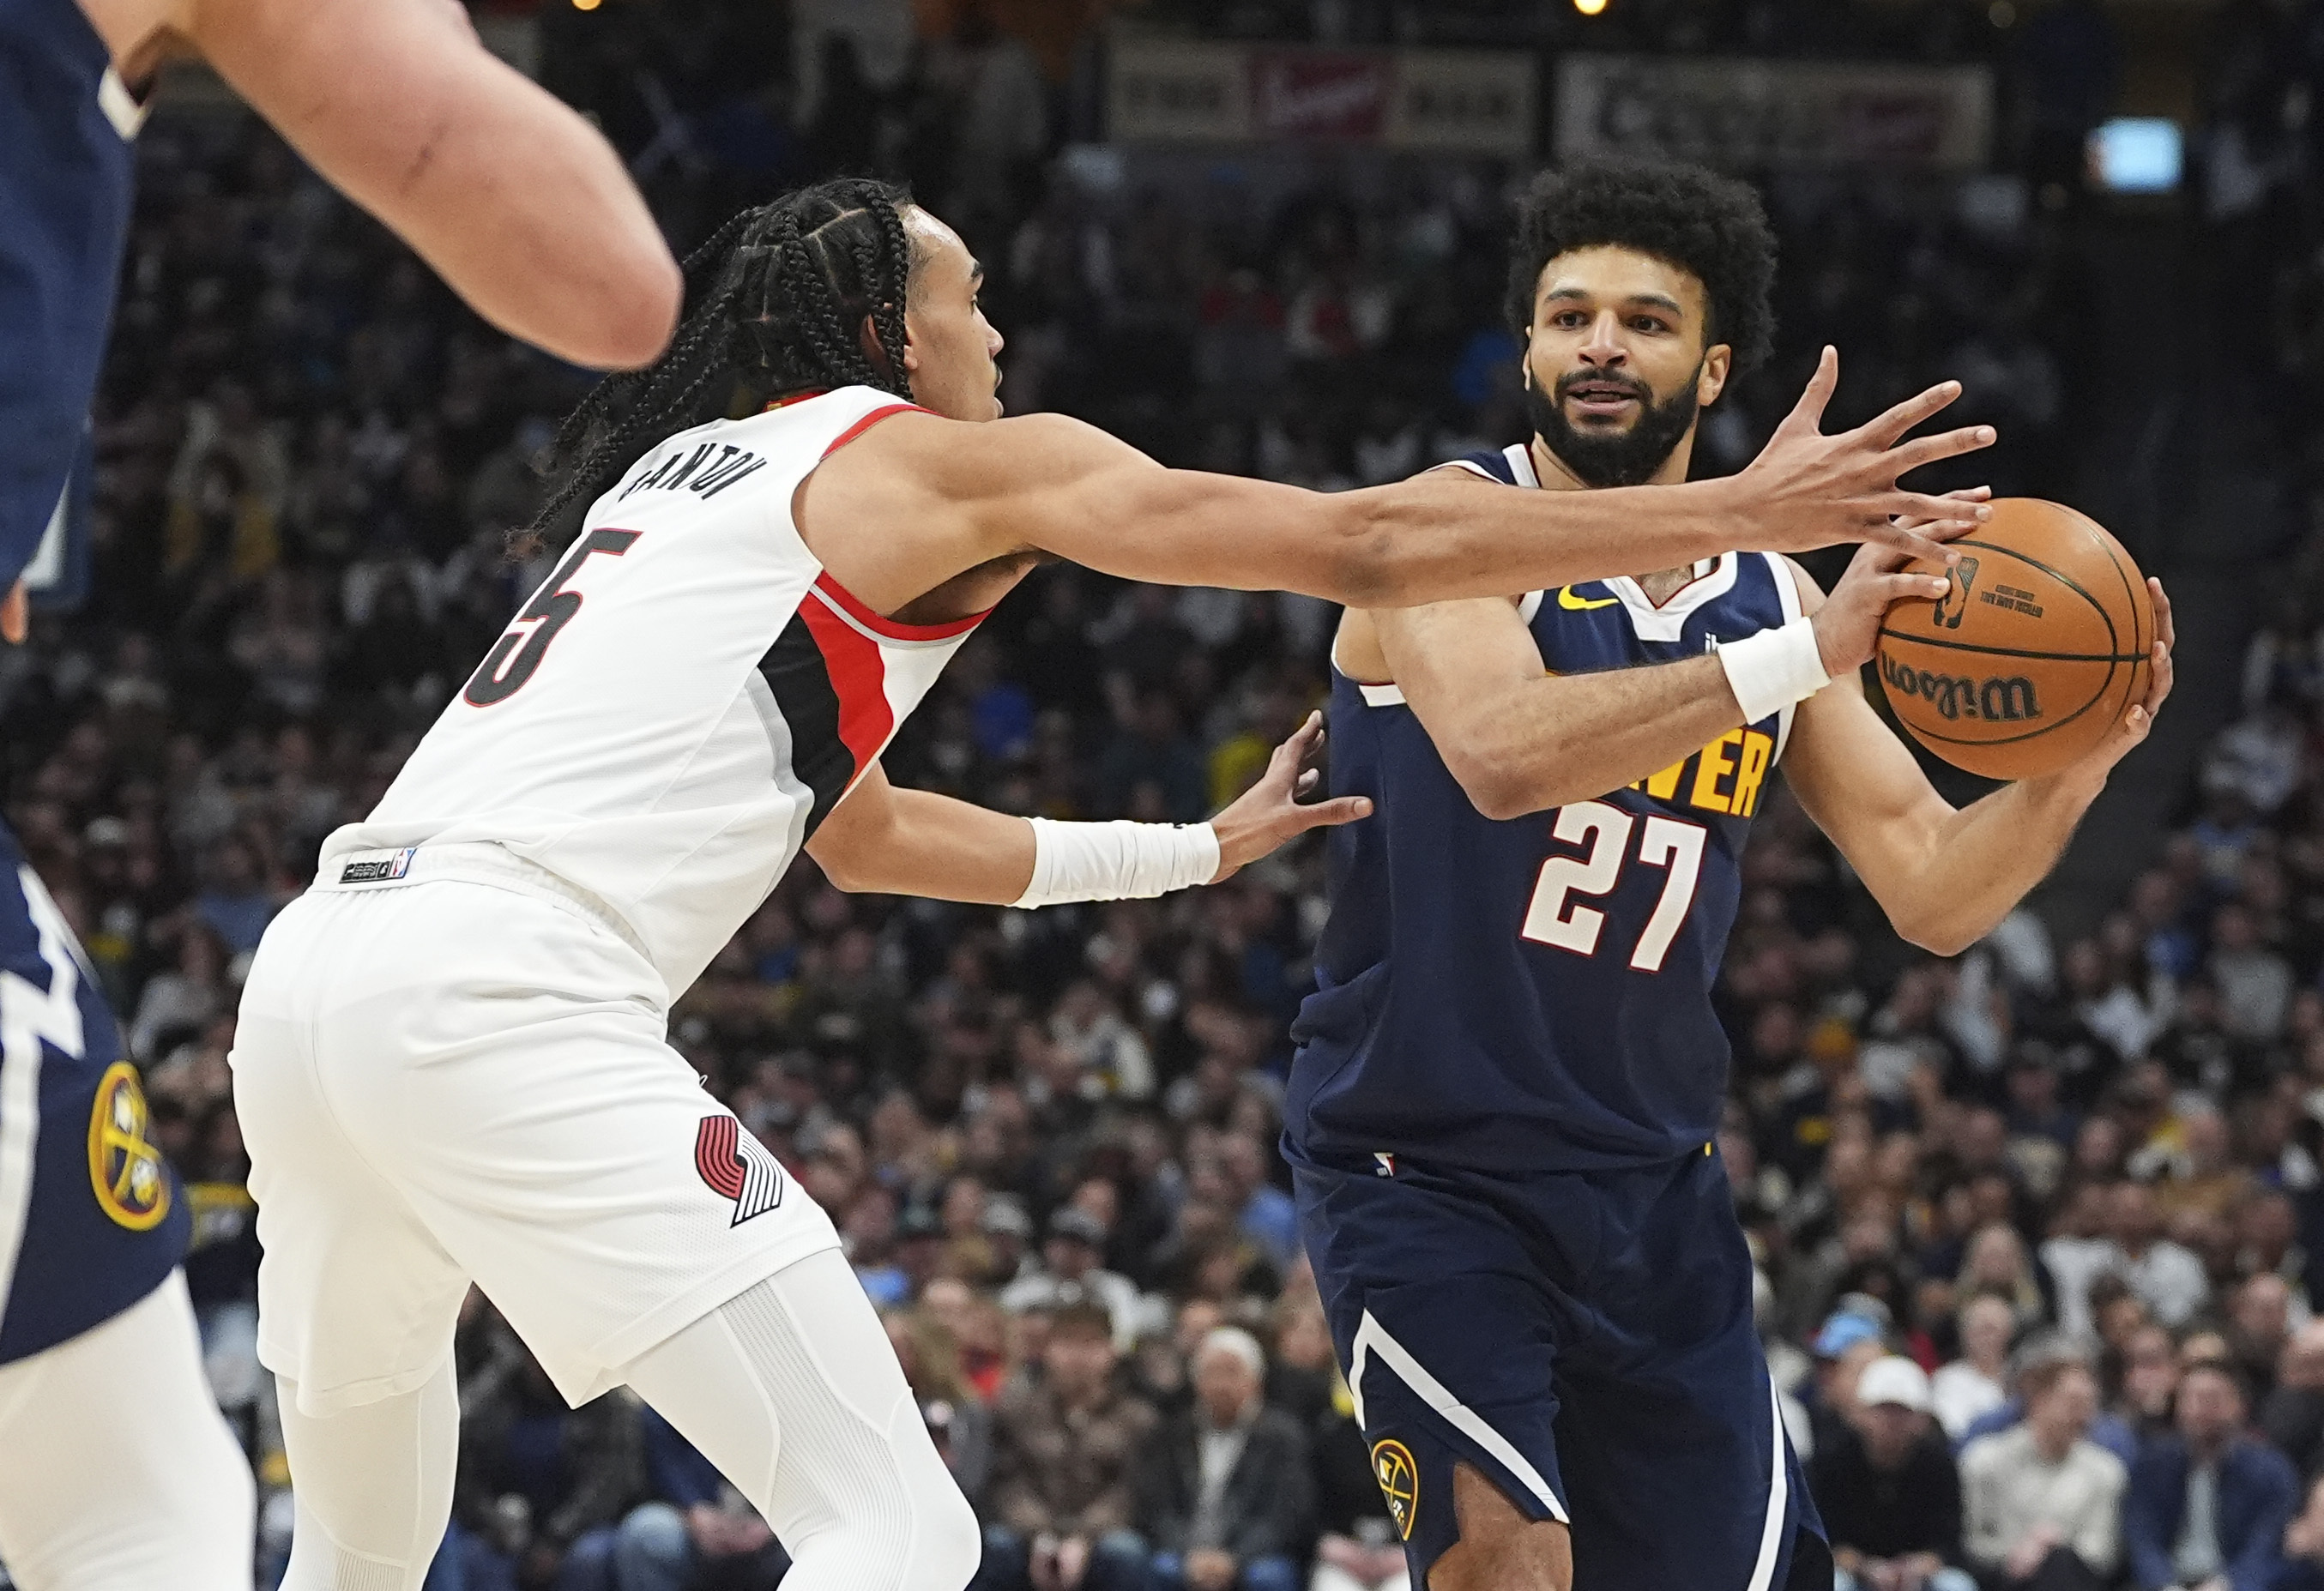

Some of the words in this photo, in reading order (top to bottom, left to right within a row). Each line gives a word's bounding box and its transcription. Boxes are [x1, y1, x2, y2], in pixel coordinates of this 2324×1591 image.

[463, 527, 643, 708] 5
[1881, 649, 2043, 721] Wilson
[1519, 799, 1709, 973] 27
